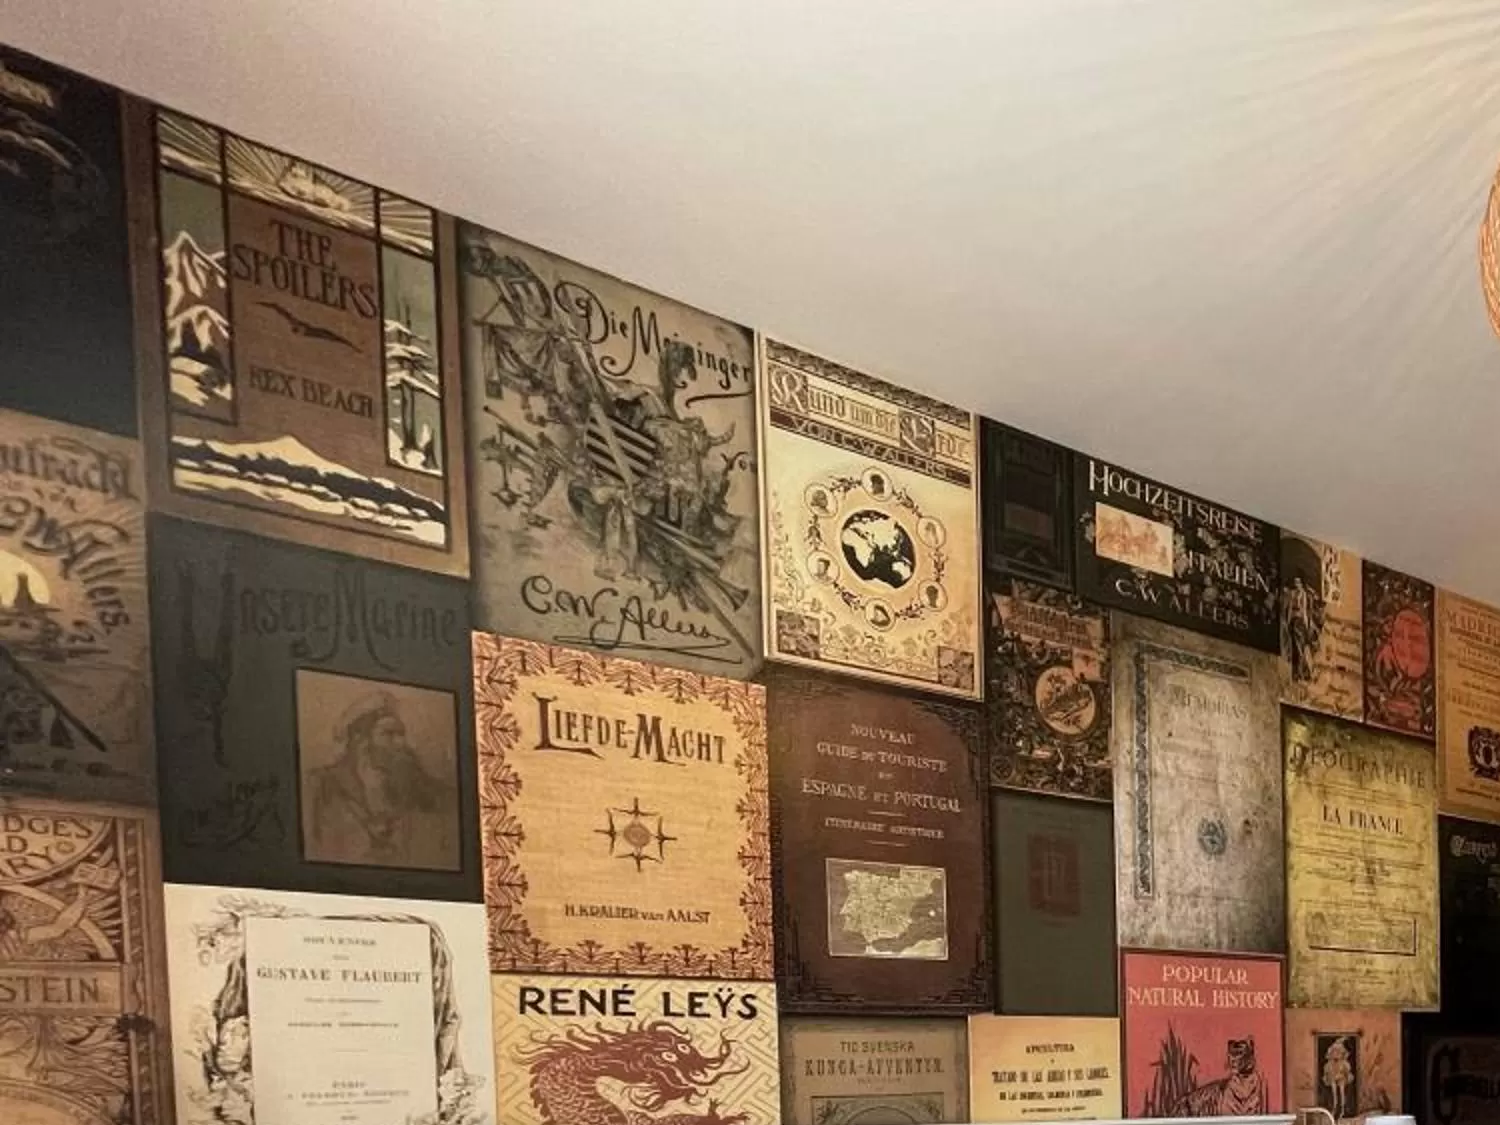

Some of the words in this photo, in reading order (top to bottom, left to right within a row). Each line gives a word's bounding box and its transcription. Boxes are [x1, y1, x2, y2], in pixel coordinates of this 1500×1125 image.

[270, 218, 338, 273] THE
[230, 242, 379, 320] SPOILERS
[248, 365, 295, 398] REX
[302, 376, 374, 419] BEACH
[1089, 458, 1263, 543] HOCHZEITSREISE
[531, 690, 728, 767] LIEFDE-MACHT
[850, 722, 917, 746] NOUVEAU
[816, 740, 859, 760] GUIDE
[877, 751, 949, 774] TOURISTE
[801, 777, 868, 801] ESPAGNE
[893, 790, 962, 813] PORTUGAL
[1349, 810, 1404, 835] FRANCE
[666, 907, 711, 925] AALST
[256, 966, 331, 984] GUSTAVE
[341, 970, 422, 985] FLAUBERT
[1161, 963, 1249, 986] POPULAR
[518, 982, 637, 1018] RENÉ
[661, 986, 759, 1021] LEŸS
[1128, 986, 1205, 1010] NATURAL
[1212, 989, 1279, 1010] HISTORY
